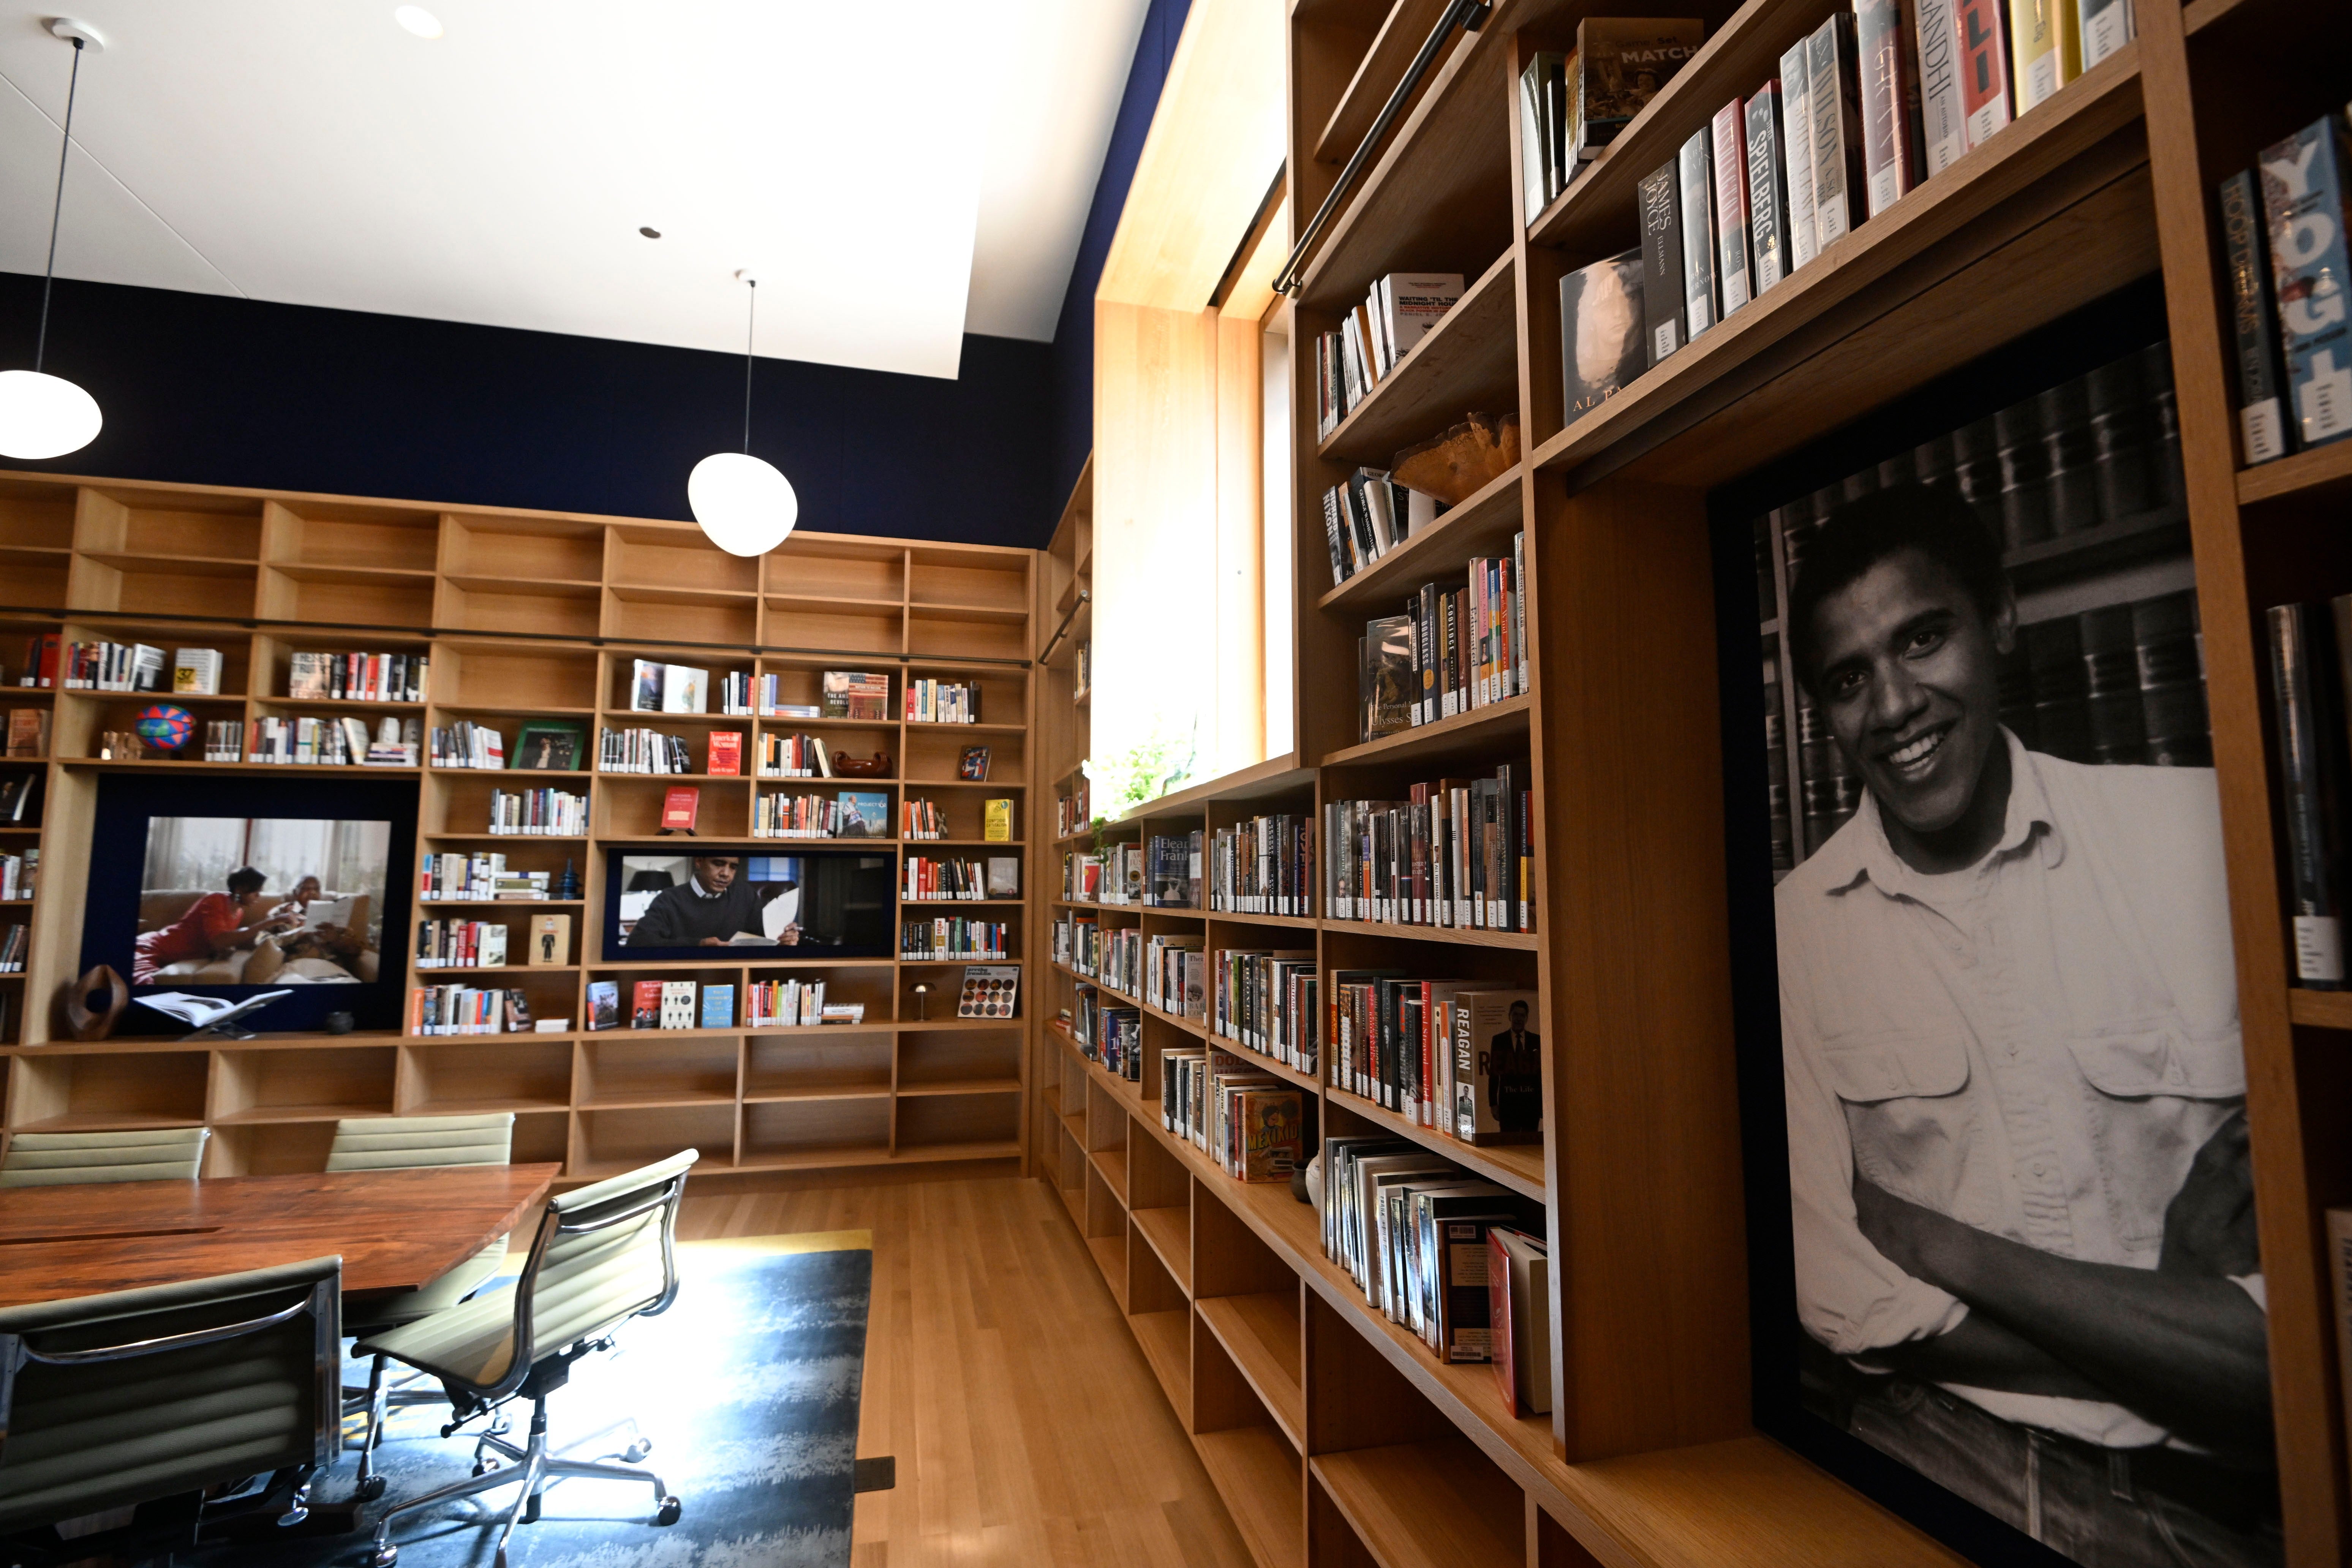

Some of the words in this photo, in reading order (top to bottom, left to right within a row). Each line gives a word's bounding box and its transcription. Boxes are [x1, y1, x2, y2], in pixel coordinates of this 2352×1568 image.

[1621, 45, 1699, 64] MATCH
[1796, 106, 1811, 161] JOHN
[1814, 67, 1838, 168] WILSON
[1657, 173, 1671, 231] JAMES
[1748, 130, 1772, 242] SPIELBERG
[1645, 182, 1660, 236] JOYCE
[1657, 235, 1666, 276] ELLMANN
[1573, 396, 1595, 412] AL
[1323, 494, 1333, 537] NIXON
[1329, 490, 1339, 531] RICHARD
[1364, 513, 1374, 548] WASHINGTO
[1383, 701, 1407, 710] Personal
[1456, 1008, 1471, 1071] REAGAN
[1247, 1124, 1298, 1151] MEXIKID
